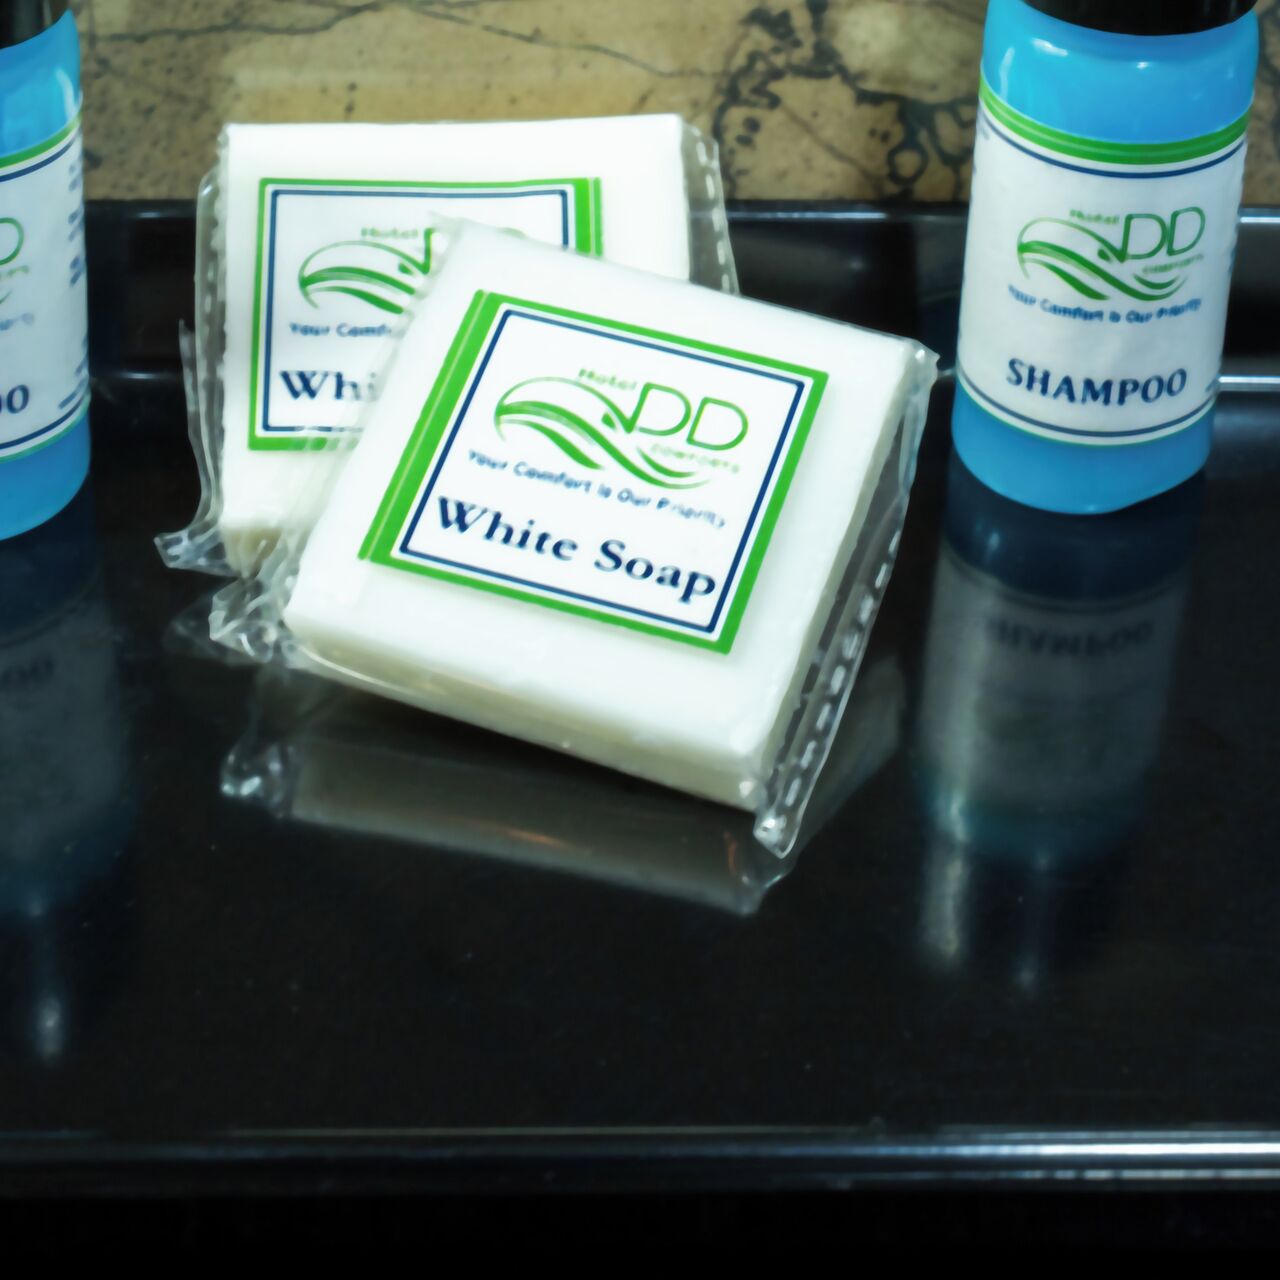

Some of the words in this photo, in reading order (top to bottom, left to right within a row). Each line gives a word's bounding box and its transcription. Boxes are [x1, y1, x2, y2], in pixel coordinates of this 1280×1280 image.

[1006, 357, 1188, 407] SHAMPOO
[513, 461, 593, 494] Comfort
[617, 487, 652, 508] Our
[437, 495, 579, 562] White
[593, 538, 716, 605] Soap
